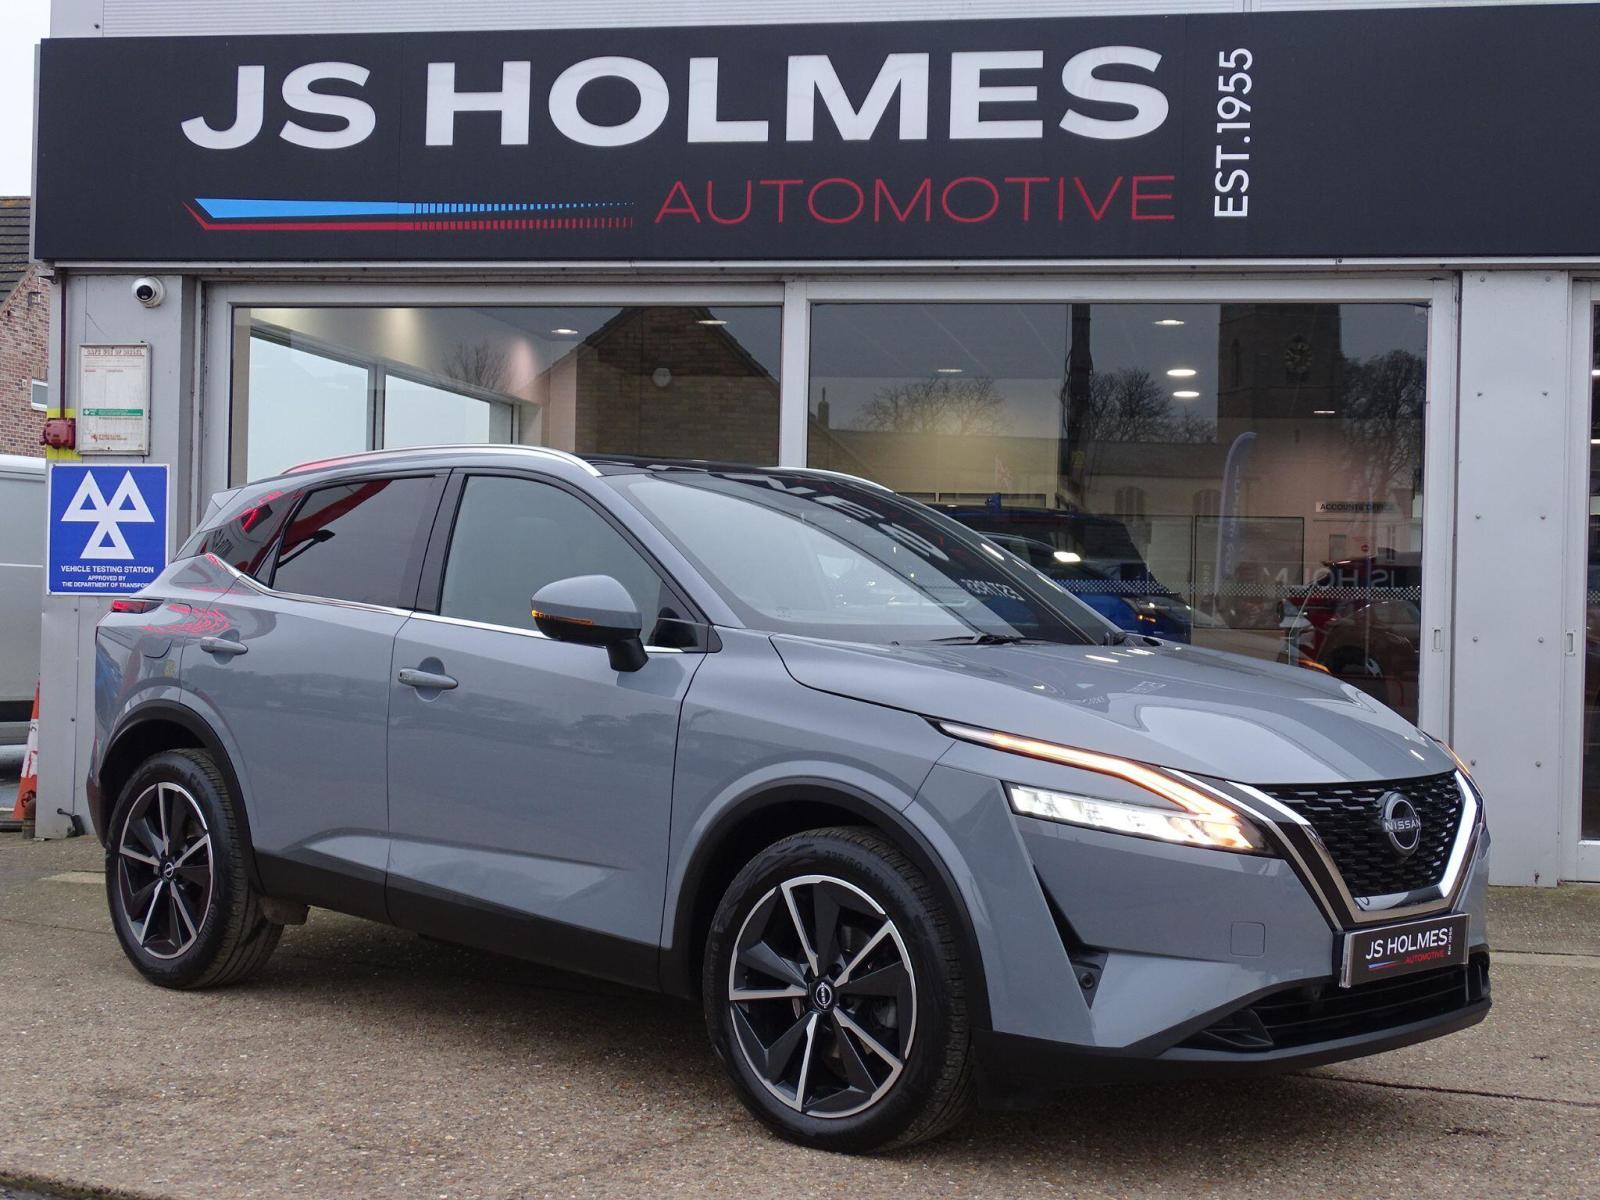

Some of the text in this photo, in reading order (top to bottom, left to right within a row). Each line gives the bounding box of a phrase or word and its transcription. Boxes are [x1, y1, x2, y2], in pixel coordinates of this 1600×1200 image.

[181, 45, 1169, 150] JS HOLMES
[1214, 47, 1253, 218] EST.1955
[654, 175, 1176, 225] AUTOMOTIVE
[61, 565, 91, 573] VEHICLE
[93, 565, 122, 573] TESTING
[1384, 819, 1421, 830] NISSAN
[1366, 938, 1384, 960] JS
[1387, 927, 1448, 955] HOLMES
[1404, 950, 1446, 965] AUTOMOTIVE
